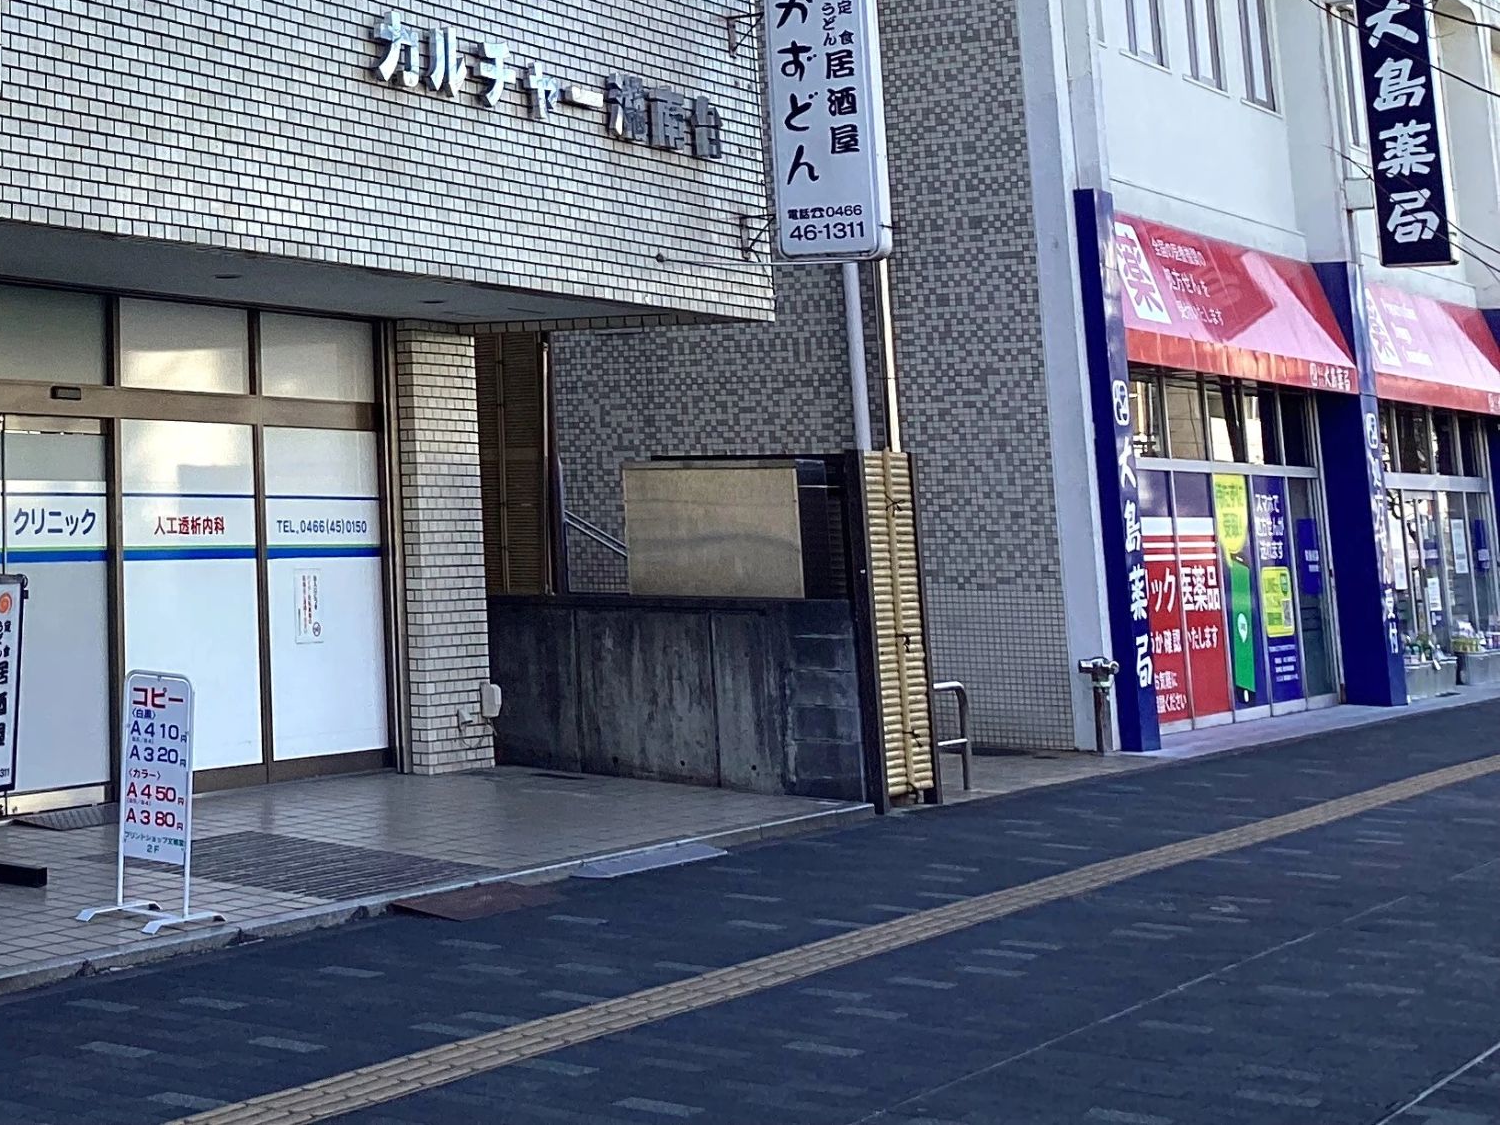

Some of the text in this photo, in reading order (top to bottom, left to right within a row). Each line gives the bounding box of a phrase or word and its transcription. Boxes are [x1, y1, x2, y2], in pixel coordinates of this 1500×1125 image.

[822, 2, 837, 46] うどん
[837, 0, 855, 46] 定食
[372, 10, 723, 160] カルチャー湘南台
[825, 51, 861, 154] 居酒屋
[789, 221, 866, 242] 46-1311
[12, 507, 97, 537] クリニック
[153, 515, 226, 536] 人工透析内科
[1118, 436, 1154, 687] 大島薬局
[133, 686, 184, 709] コピー
[130, 720, 156, 738] A4
[129, 745, 154, 763] A3
[126, 781, 153, 800] A4
[126, 807, 151, 826] A3
[146, 844, 160, 854] 2F
